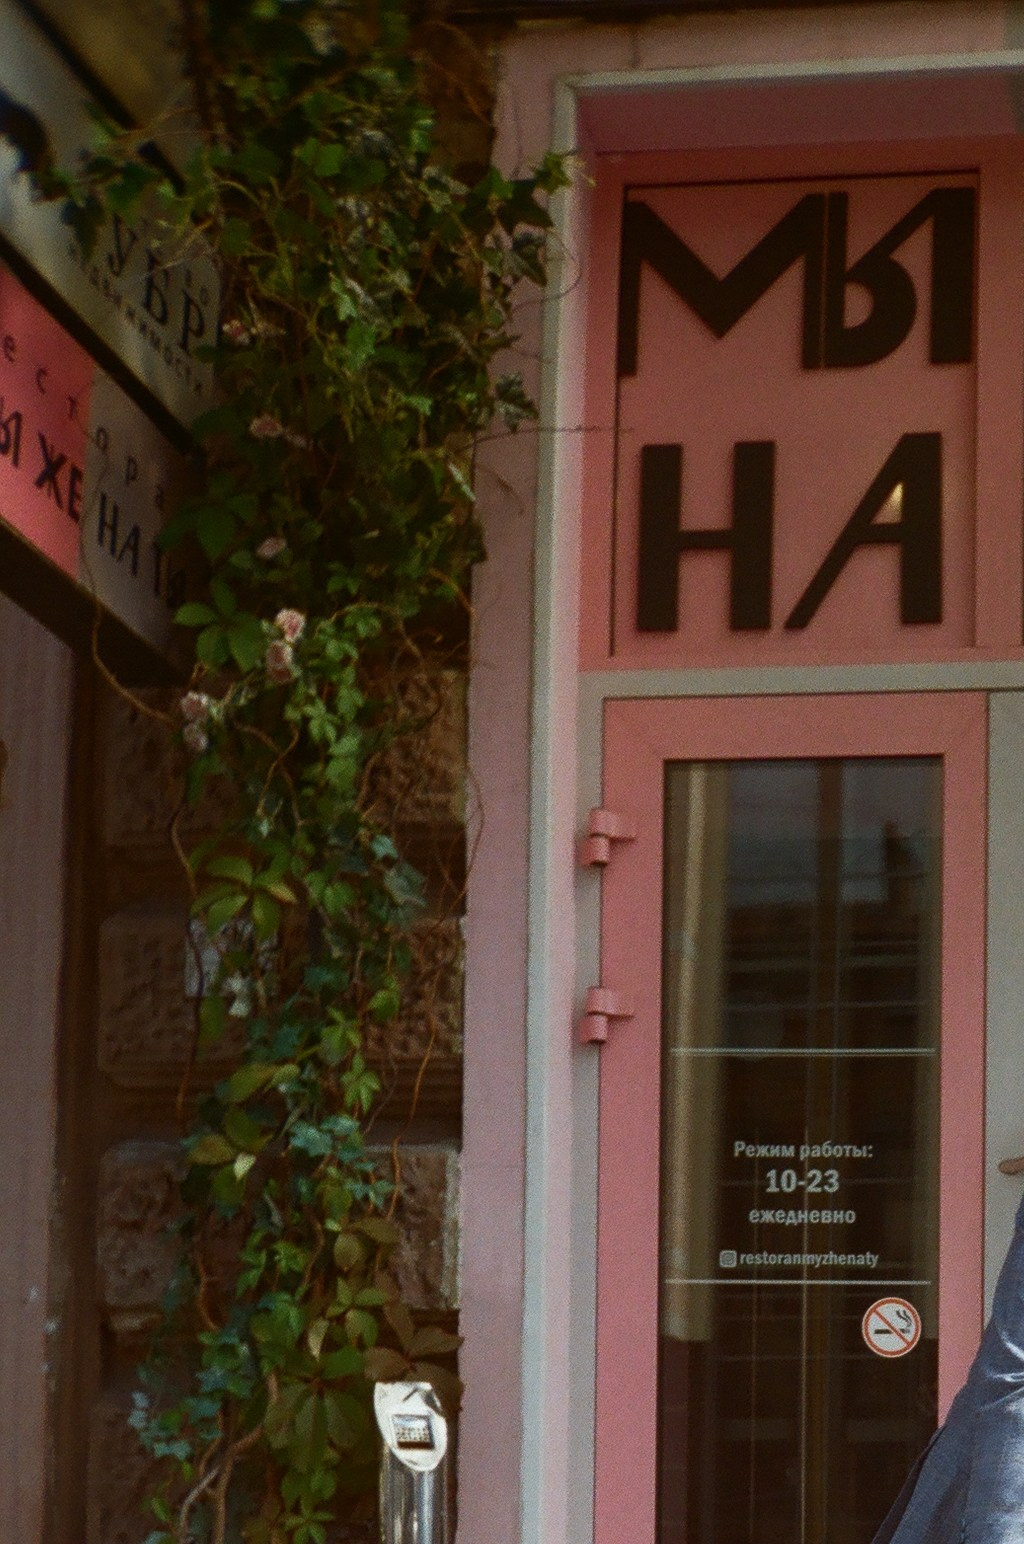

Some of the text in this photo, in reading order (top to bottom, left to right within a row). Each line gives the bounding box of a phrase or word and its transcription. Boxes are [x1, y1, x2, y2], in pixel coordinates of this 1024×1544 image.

[617, 187, 977, 376] МЫ
[34, 430, 84, 525] ЖЕ
[99, 492, 141, 578] НА
[635, 433, 943, 633] НА
[733, 1140, 874, 1161] Режим работы:
[765, 1168, 840, 1193] 10-23
[749, 1209, 857, 1226] ежедневно
[740, 1250, 879, 1268] restoranmyzhenaty
